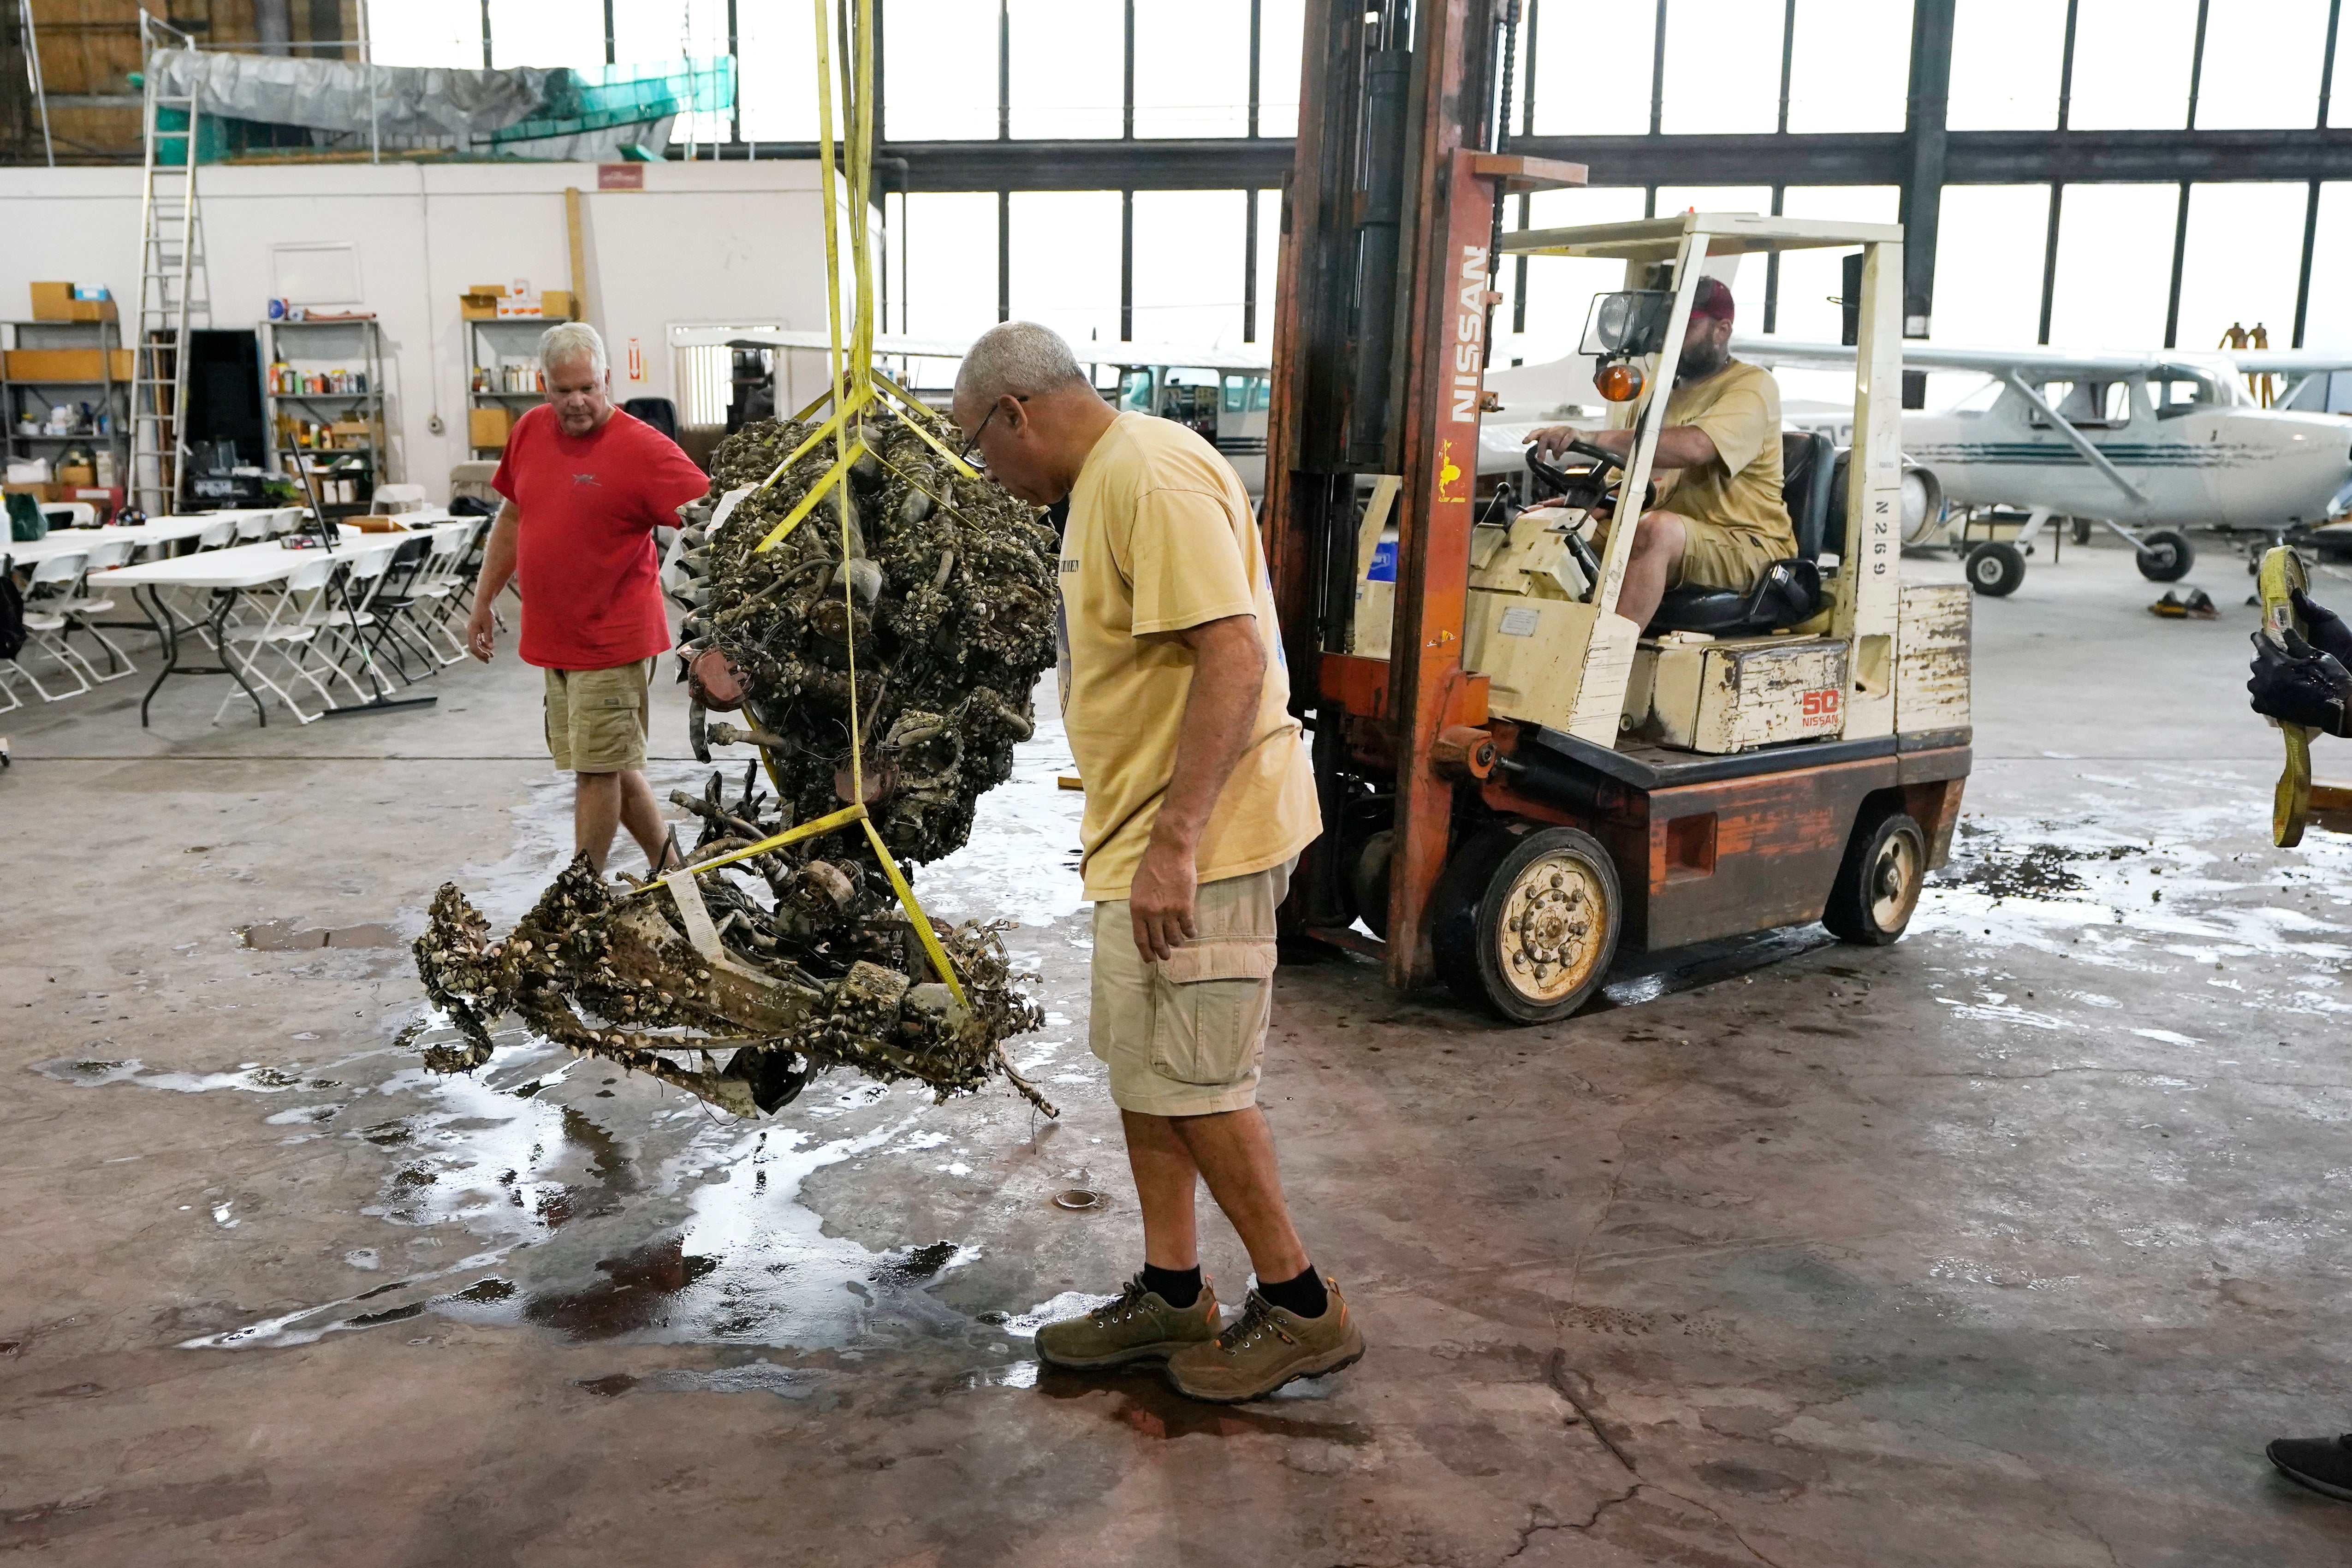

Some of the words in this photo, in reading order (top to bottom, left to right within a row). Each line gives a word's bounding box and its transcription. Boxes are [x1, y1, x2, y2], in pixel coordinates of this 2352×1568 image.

[1452, 246, 1487, 422] NISSAN
[1874, 501, 1889, 575] N269
[1802, 714, 1839, 727] NISSAN
[1803, 690, 1838, 715] 50
